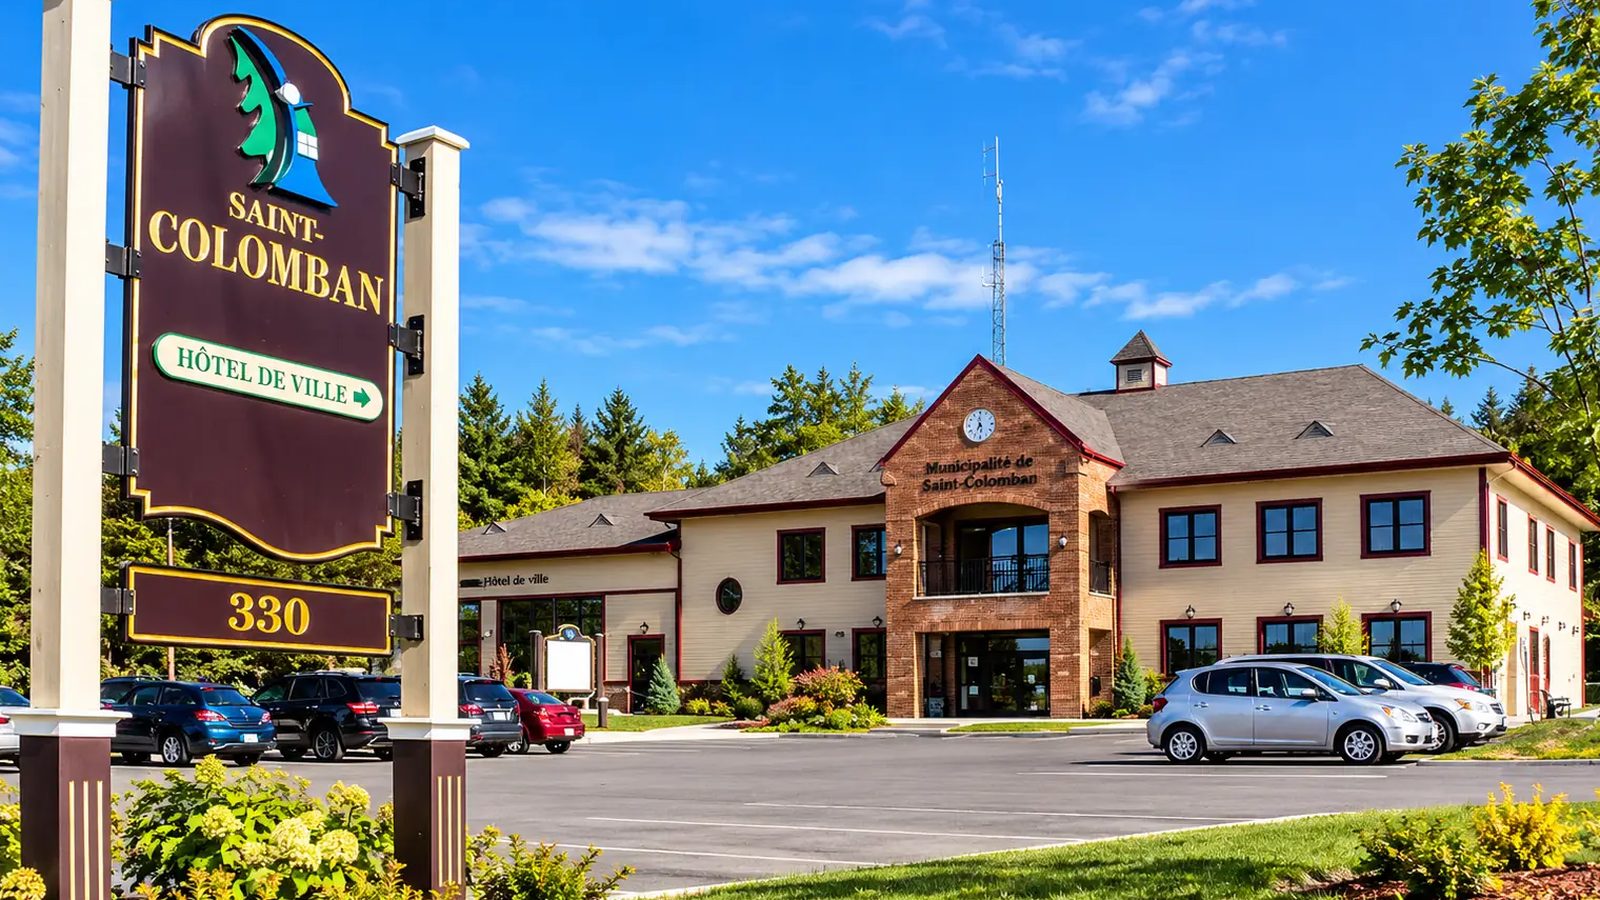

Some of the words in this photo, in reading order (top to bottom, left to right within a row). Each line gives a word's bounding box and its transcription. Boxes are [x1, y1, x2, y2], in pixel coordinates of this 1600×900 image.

[228, 191, 324, 243] SAINT-
[148, 210, 384, 315] COLOMBAN
[177, 346, 252, 383] HÔTEL
[257, 365, 286, 391] DE
[291, 373, 347, 404] VILLE
[922, 472, 1038, 492] Saint-Colomban
[925, 456, 1011, 474] Municipalité
[1016, 454, 1034, 468] de
[483, 575, 510, 587] Hôtel
[513, 574, 525, 586] de
[528, 573, 549, 584] ville
[228, 592, 310, 635] 330
